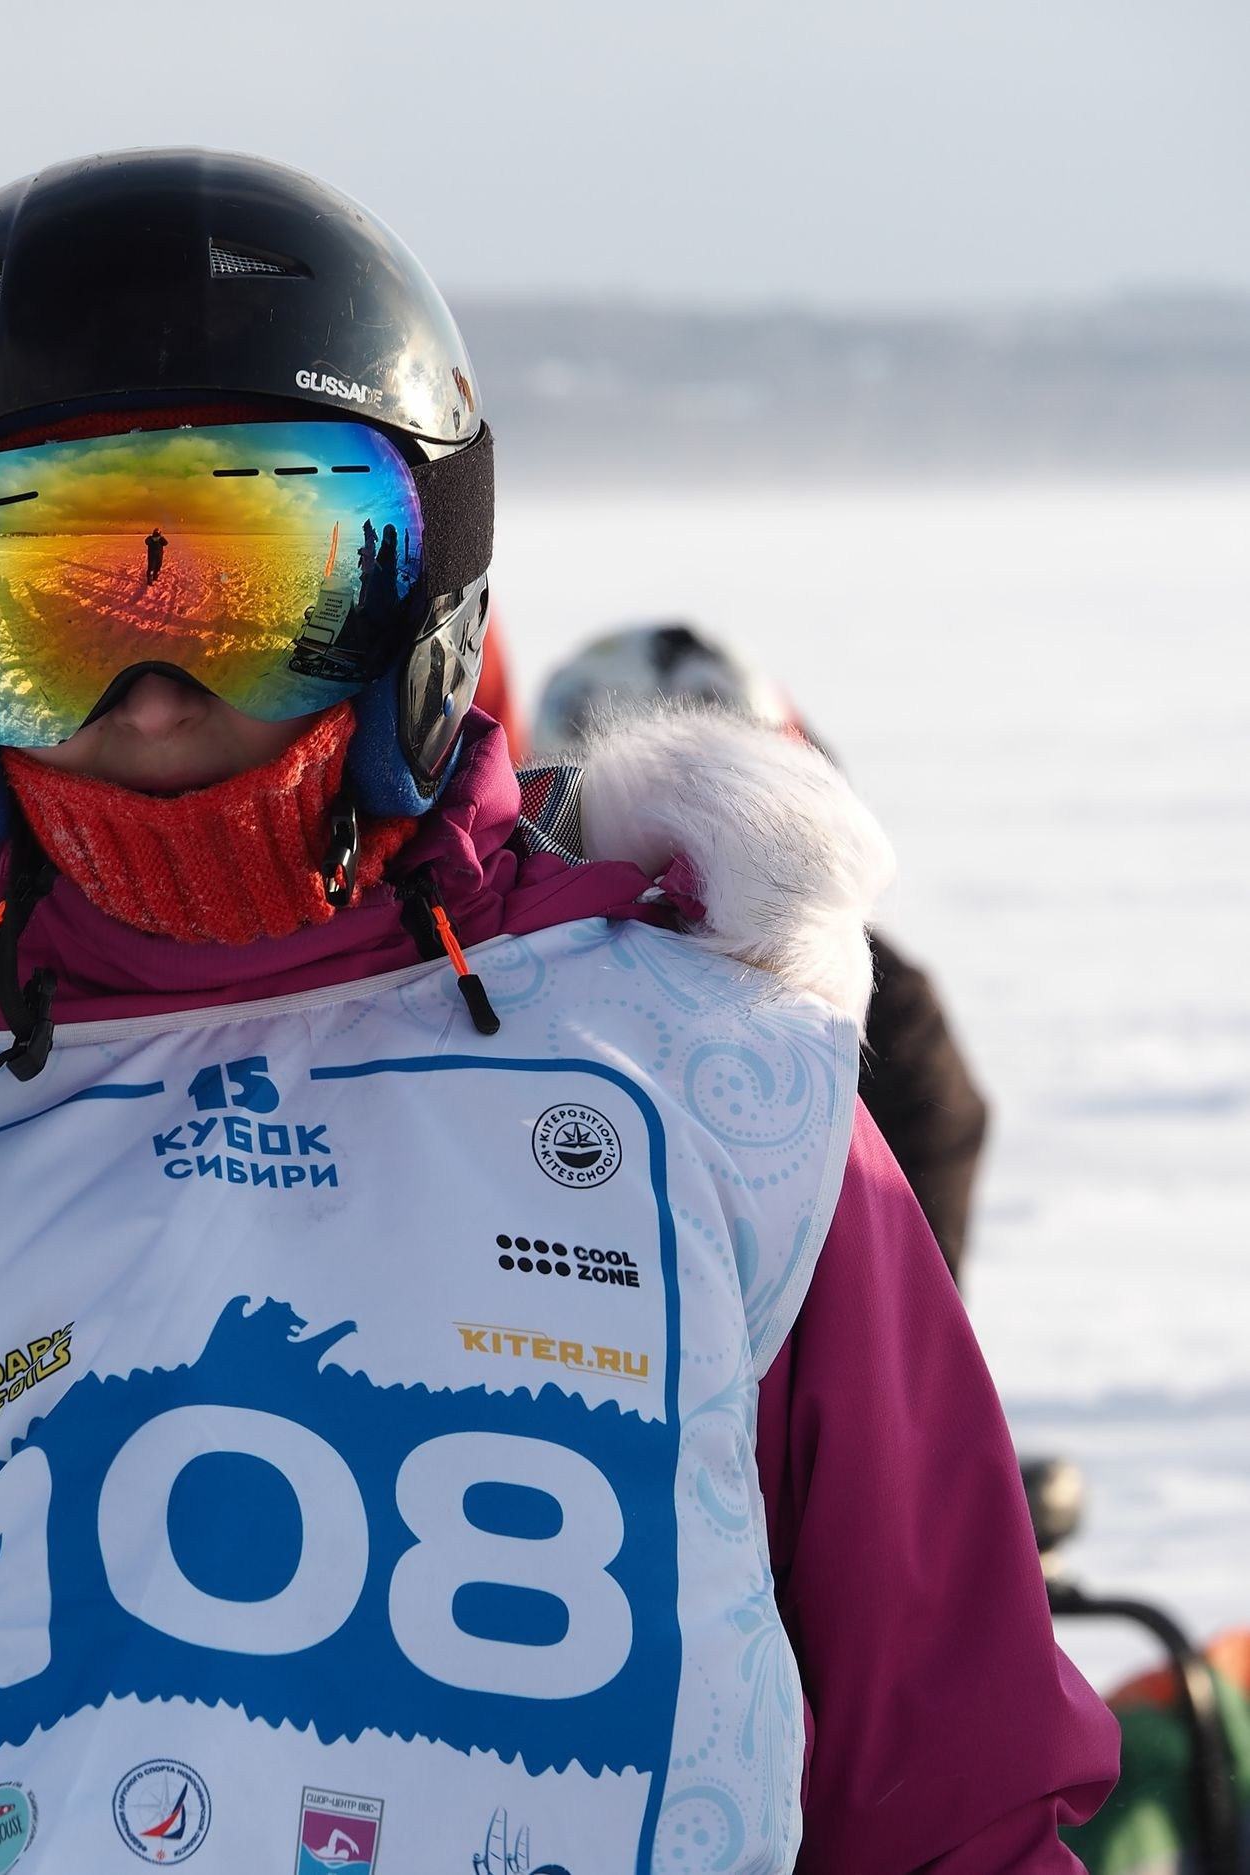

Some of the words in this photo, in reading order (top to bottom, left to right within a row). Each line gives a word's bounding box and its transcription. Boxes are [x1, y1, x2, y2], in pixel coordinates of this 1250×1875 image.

[187, 1055, 280, 1114] 15
[153, 1116, 331, 1157] КУБОК
[539, 1108, 615, 1148] KITEPOSITION
[164, 1154, 338, 1188] СИБИРИ
[540, 1149, 617, 1183] KITESCHOOL
[573, 1245, 637, 1267] COOL
[576, 1263, 640, 1288] ZONE
[457, 1328, 648, 1378] KITER.RU
